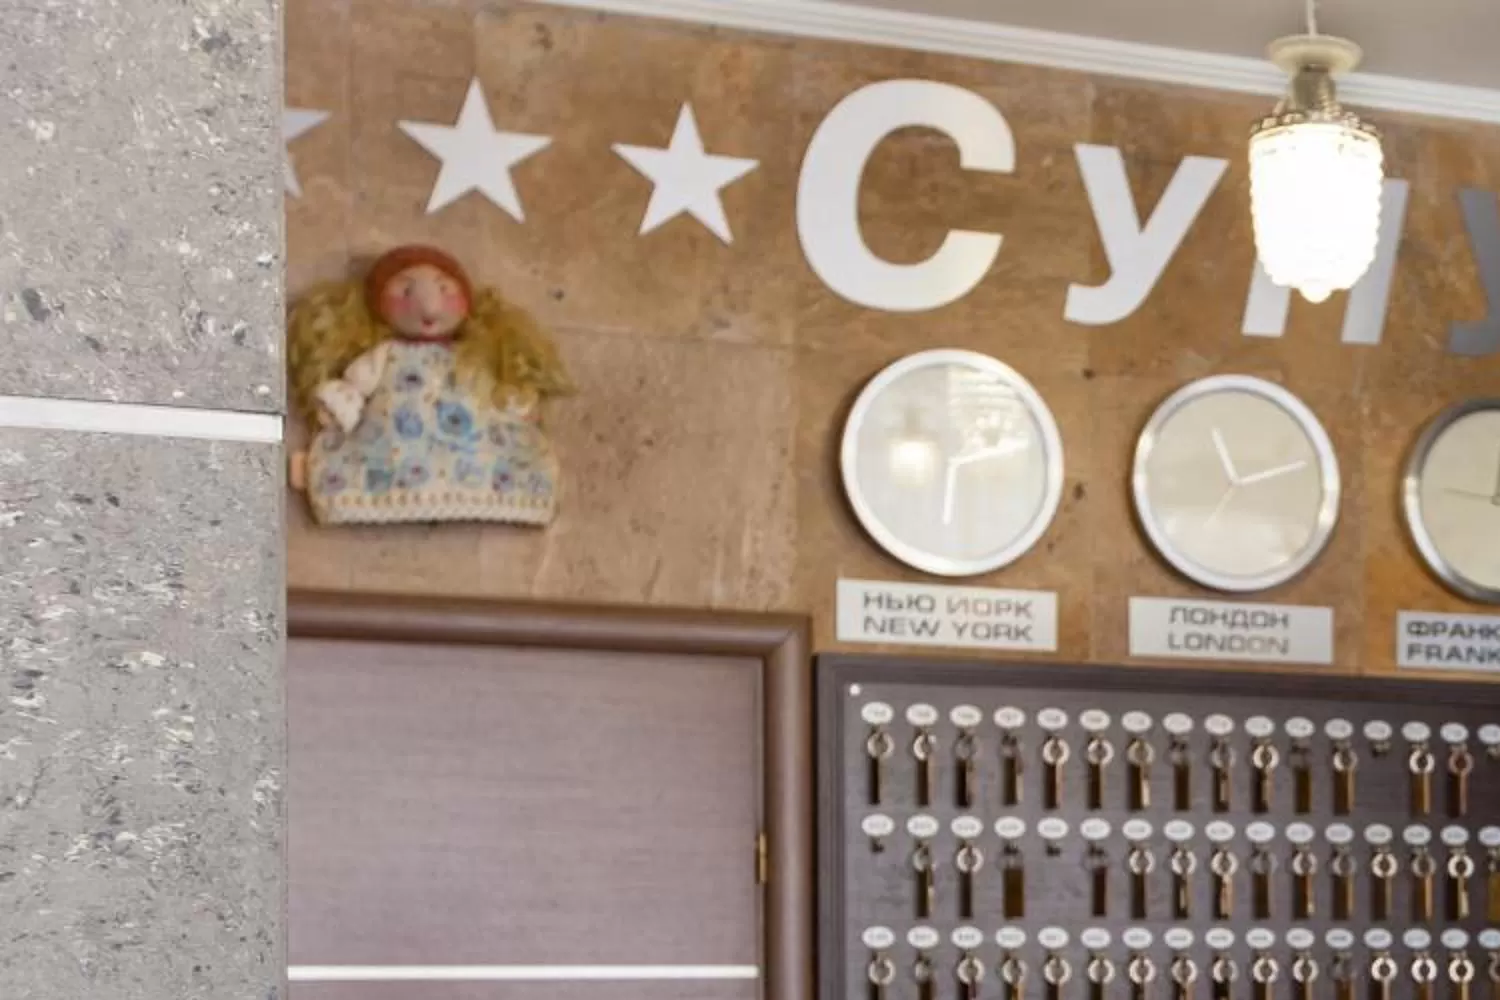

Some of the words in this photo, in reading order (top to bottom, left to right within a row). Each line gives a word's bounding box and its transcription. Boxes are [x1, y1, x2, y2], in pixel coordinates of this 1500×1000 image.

[863, 591, 937, 614] НЬЮ
[863, 615, 941, 638] NEW
[951, 620, 1033, 643] YORK
[1168, 605, 1290, 629] ЛОНДОН
[1168, 631, 1290, 655] LONDON
